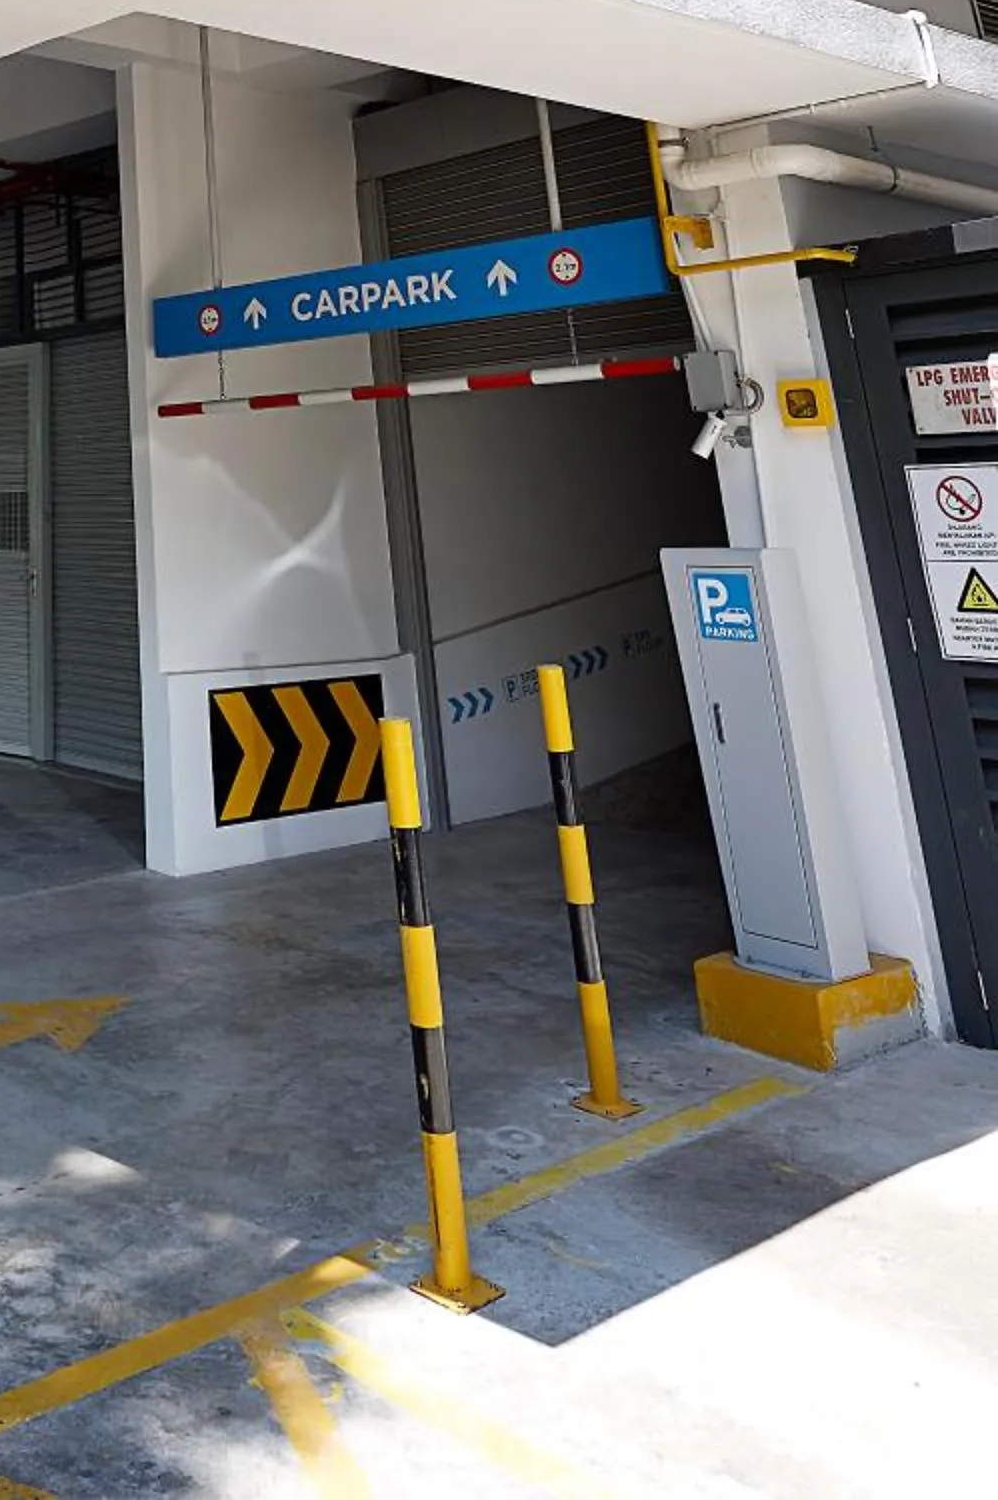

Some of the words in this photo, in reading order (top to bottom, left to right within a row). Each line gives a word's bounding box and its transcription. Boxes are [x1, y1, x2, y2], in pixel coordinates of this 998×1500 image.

[291, 269, 457, 323] CARPARK
[916, 369, 943, 387] LPG
[697, 578, 728, 624] P
[705, 626, 755, 640] PARKING
